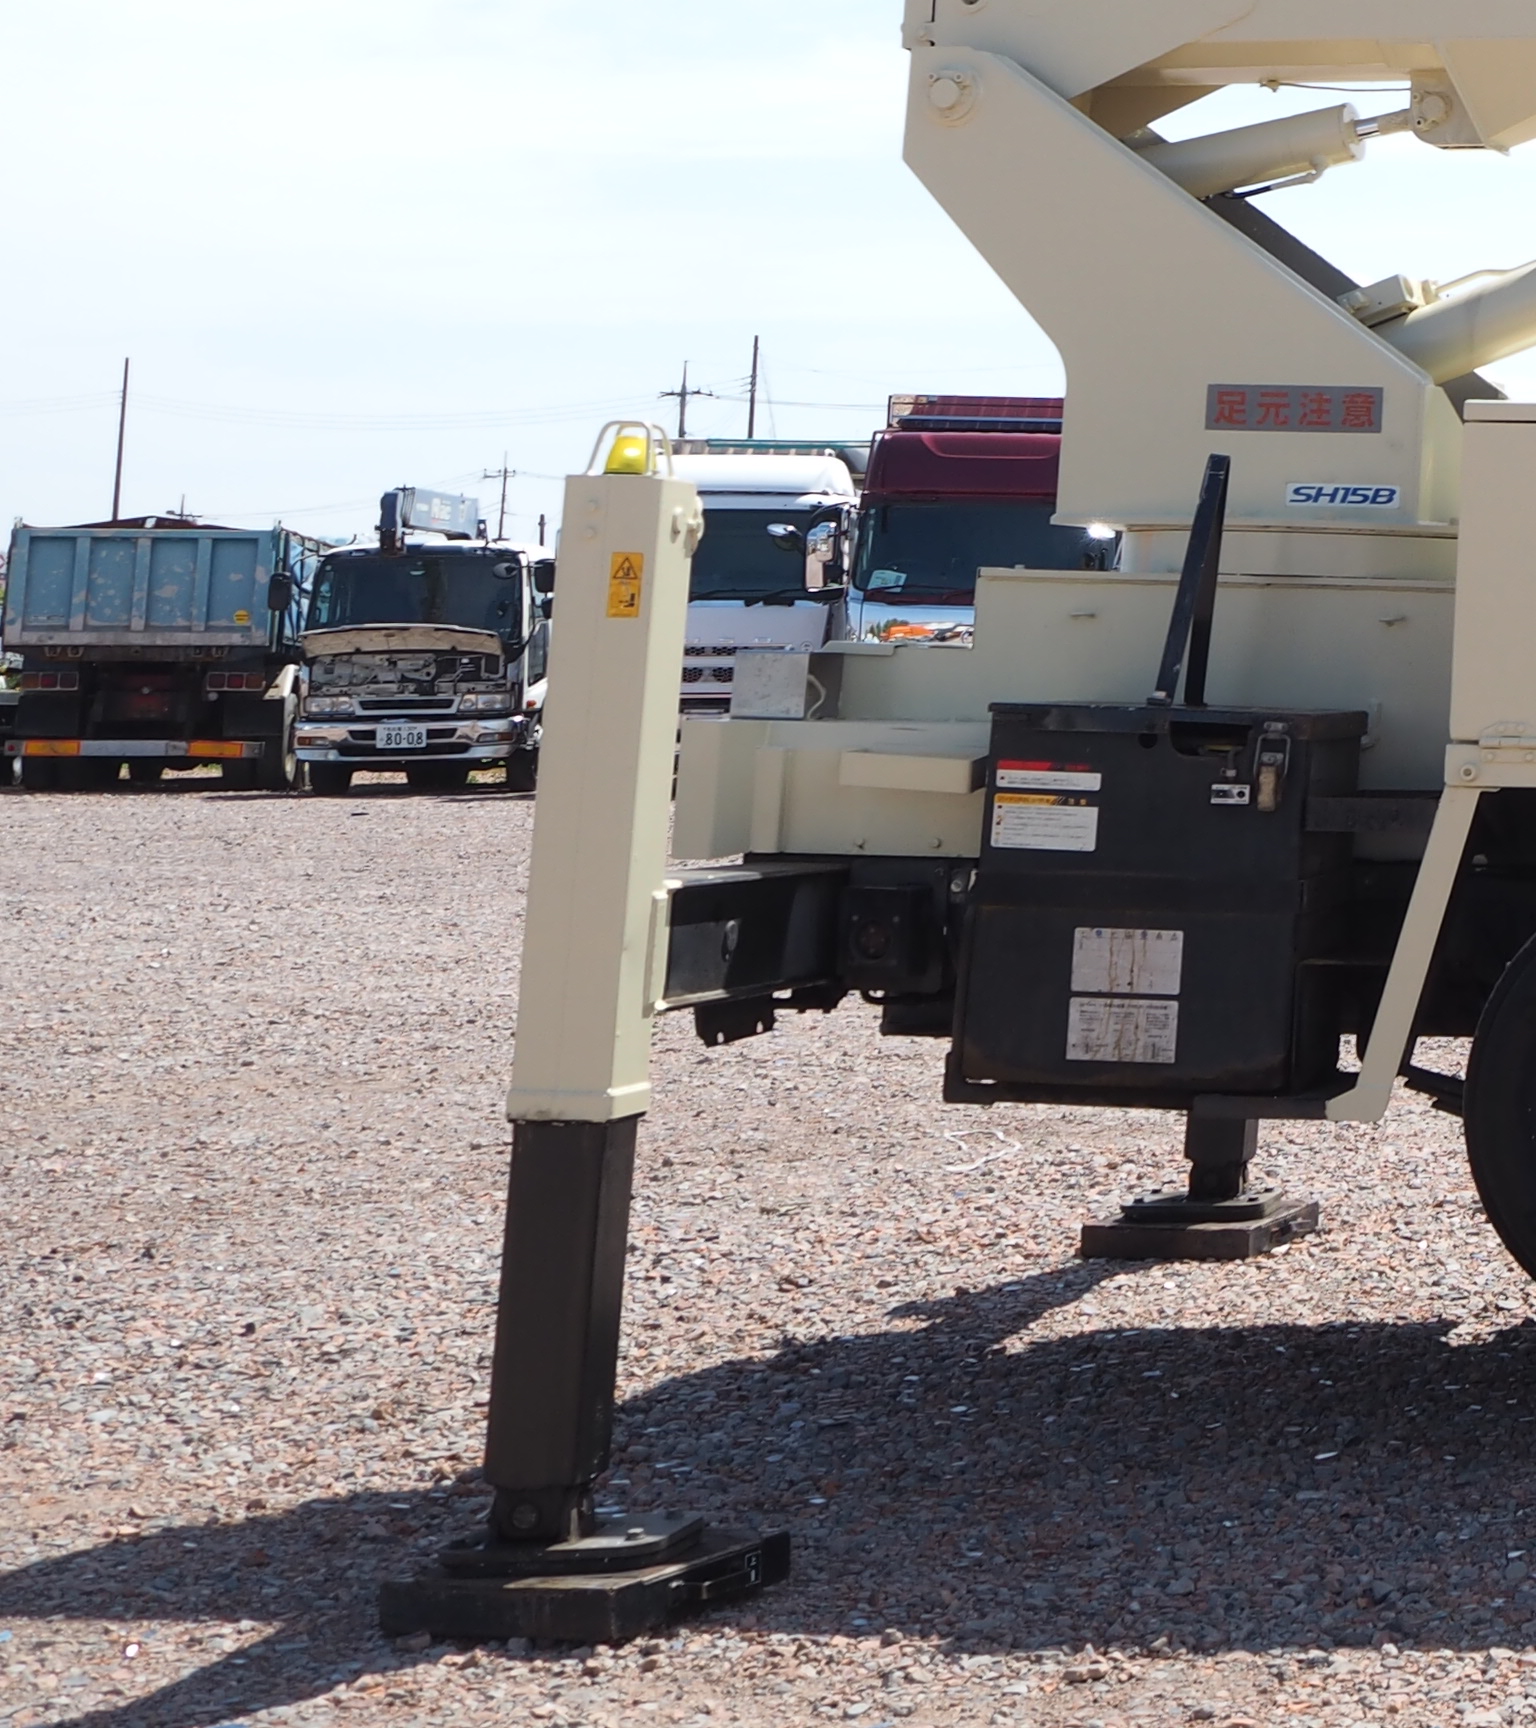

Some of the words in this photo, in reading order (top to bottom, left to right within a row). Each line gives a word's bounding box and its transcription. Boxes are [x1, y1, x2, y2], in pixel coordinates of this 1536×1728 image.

[1213, 390, 1376, 428] 足元注意
[1289, 485, 1397, 505] SH15B
